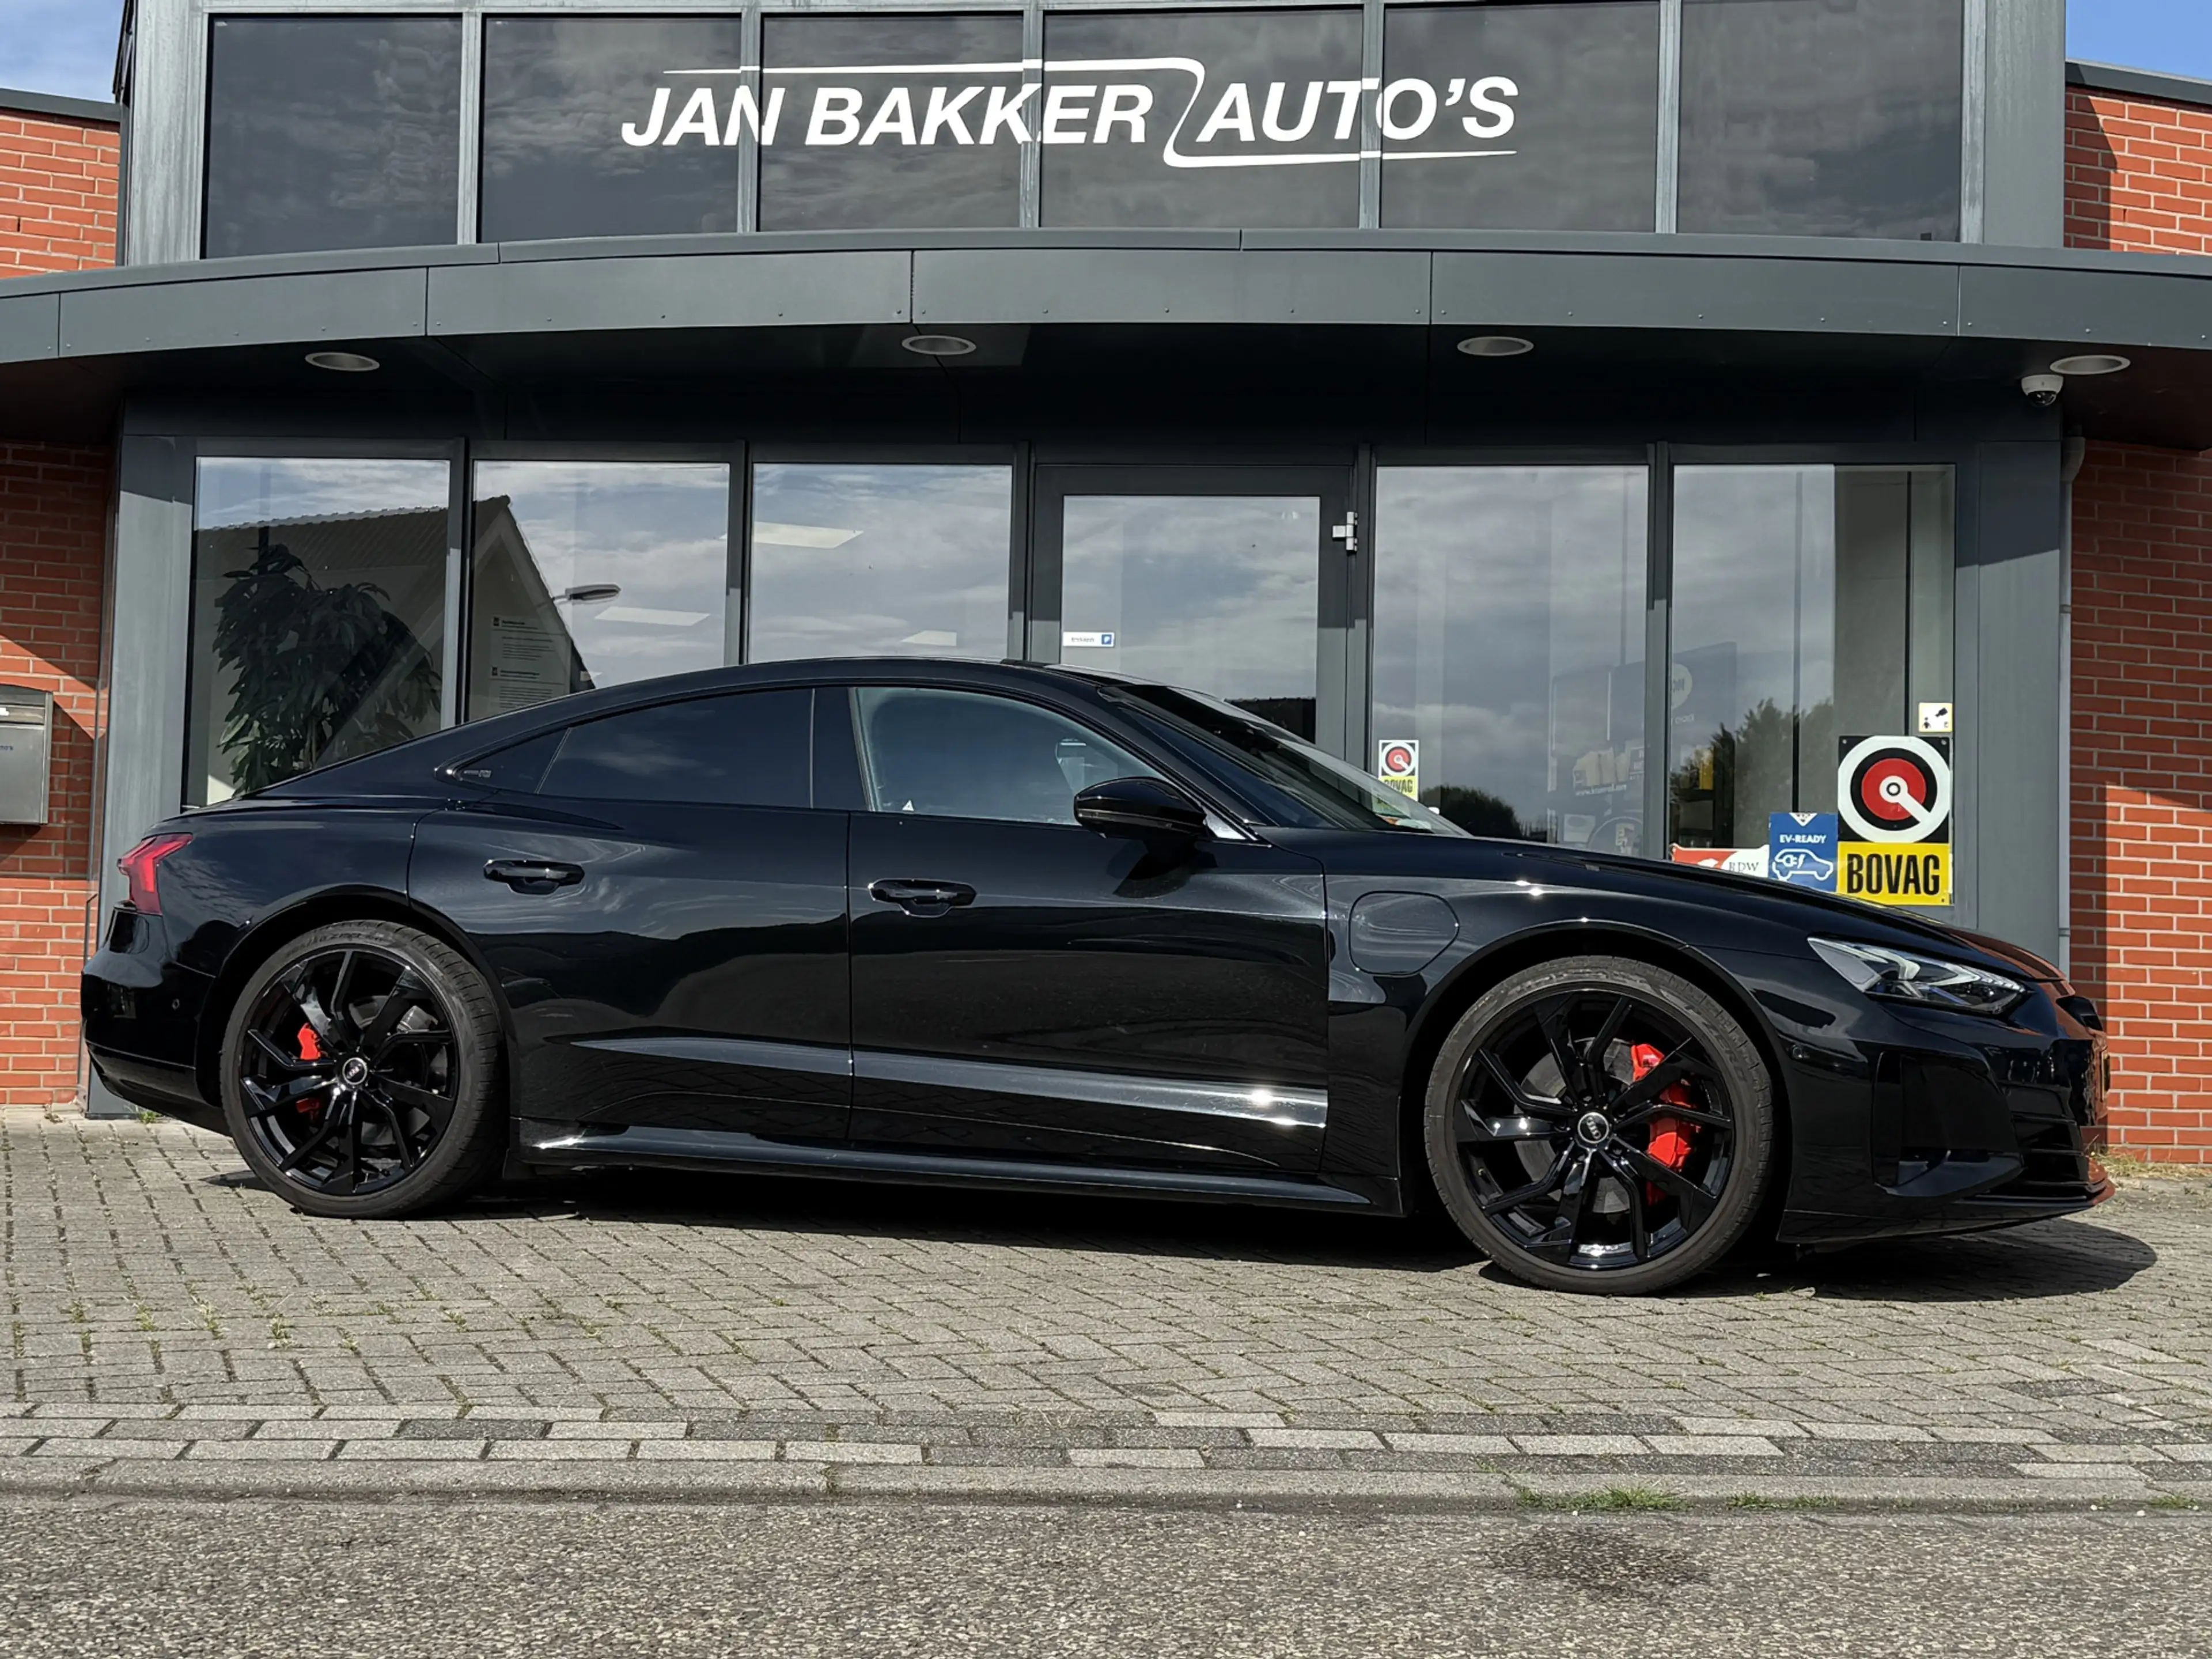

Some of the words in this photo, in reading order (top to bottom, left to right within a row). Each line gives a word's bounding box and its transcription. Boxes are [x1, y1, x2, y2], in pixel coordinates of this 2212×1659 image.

[621, 85, 786, 146] JAN
[805, 83, 1153, 145] BAKKER
[1195, 76, 1519, 142] AUTO'S
[1779, 834, 1827, 844] EV-READY
[1728, 861, 1759, 873] RDW
[1847, 853, 1940, 896] BOVAG
